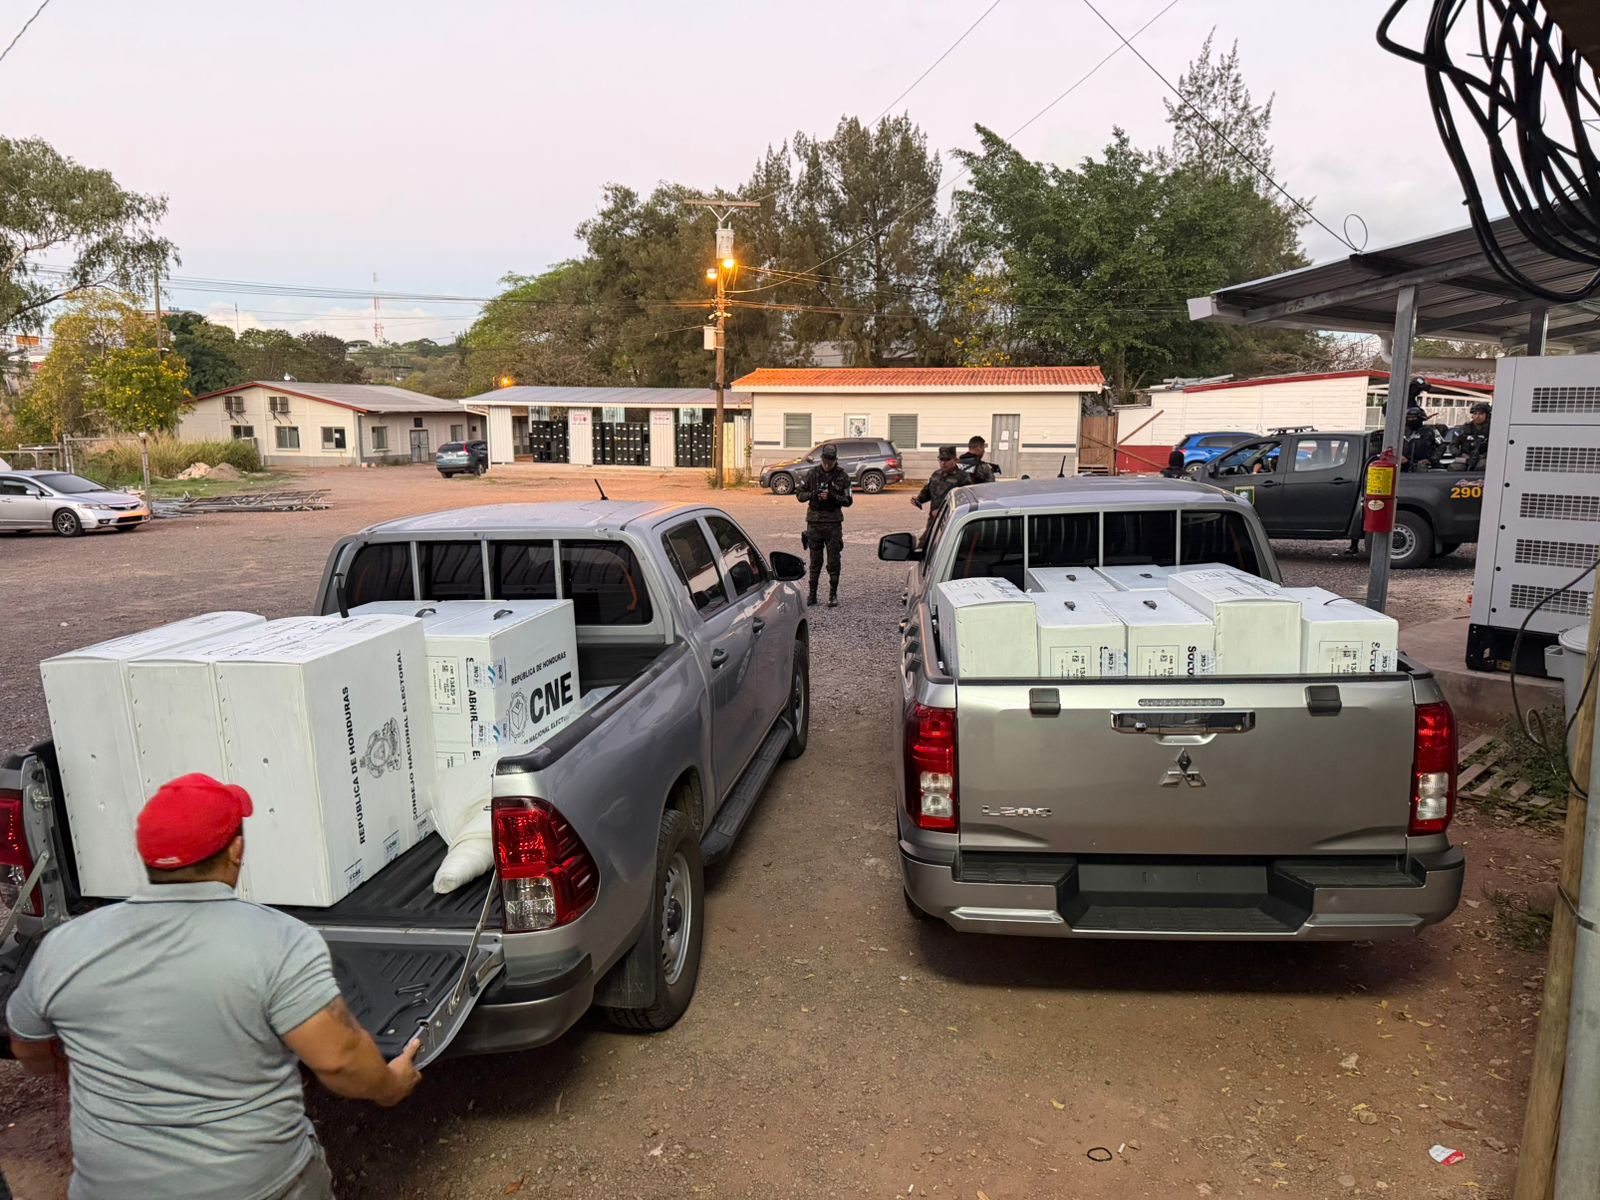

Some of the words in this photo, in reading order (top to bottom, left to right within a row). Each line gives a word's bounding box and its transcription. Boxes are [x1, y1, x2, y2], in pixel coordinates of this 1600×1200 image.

[396, 649, 408, 712] ELECTORAL
[536, 662, 542, 672] DE
[543, 651, 566, 669] HONDURAS
[341, 686, 356, 755] HONDURAS
[467, 689, 479, 722] ABRIR
[529, 670, 573, 724] CNE
[350, 757, 358, 775] DE
[403, 715, 413, 769] NACIONAL
[408, 772, 418, 821] CONSEJO
